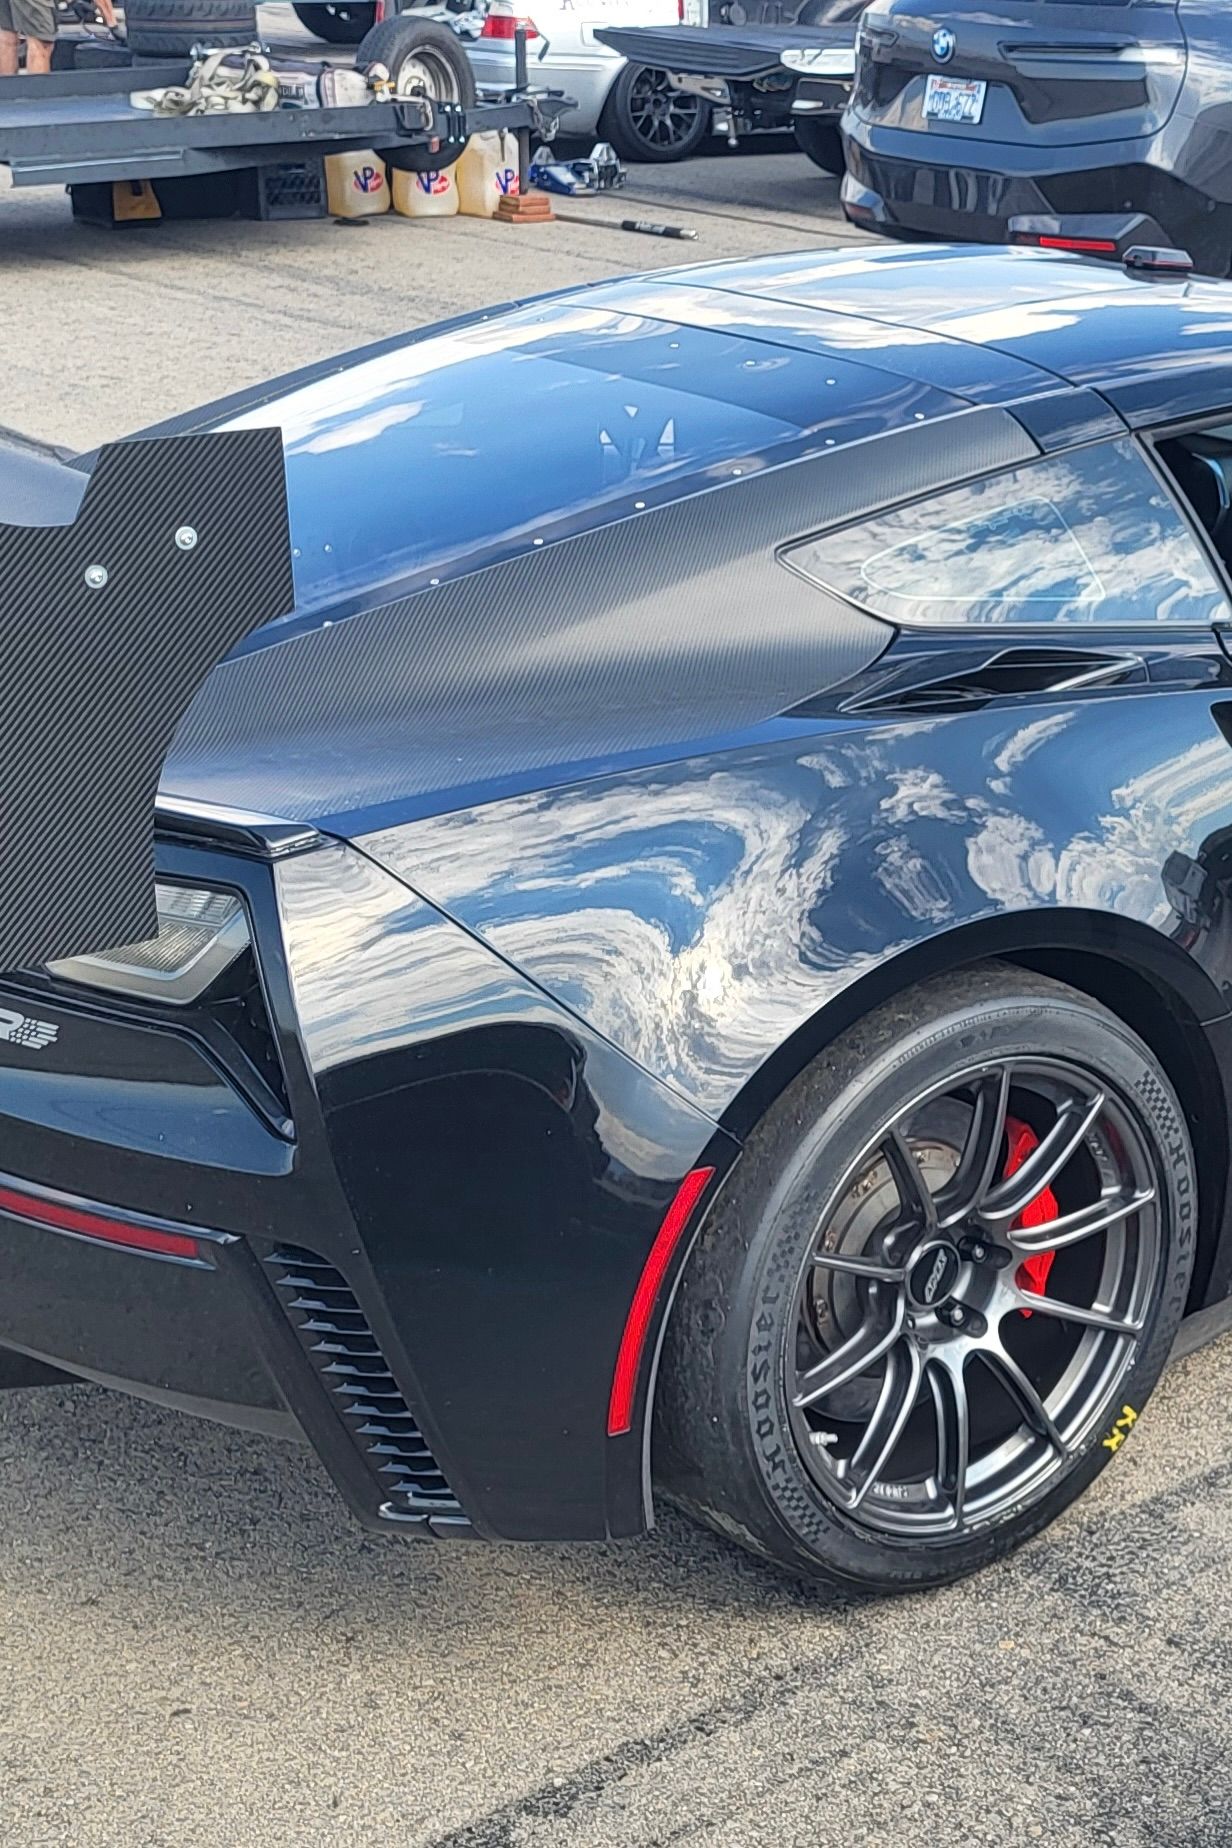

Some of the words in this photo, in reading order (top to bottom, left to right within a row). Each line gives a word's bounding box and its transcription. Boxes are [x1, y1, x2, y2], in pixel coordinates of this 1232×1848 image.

[353, 166, 374, 193] VP
[416, 171, 440, 194] VP
[495, 169, 515, 194] VP
[1168, 1136, 1193, 1313] Hoosier
[751, 1284, 788, 1480] Hoosier
